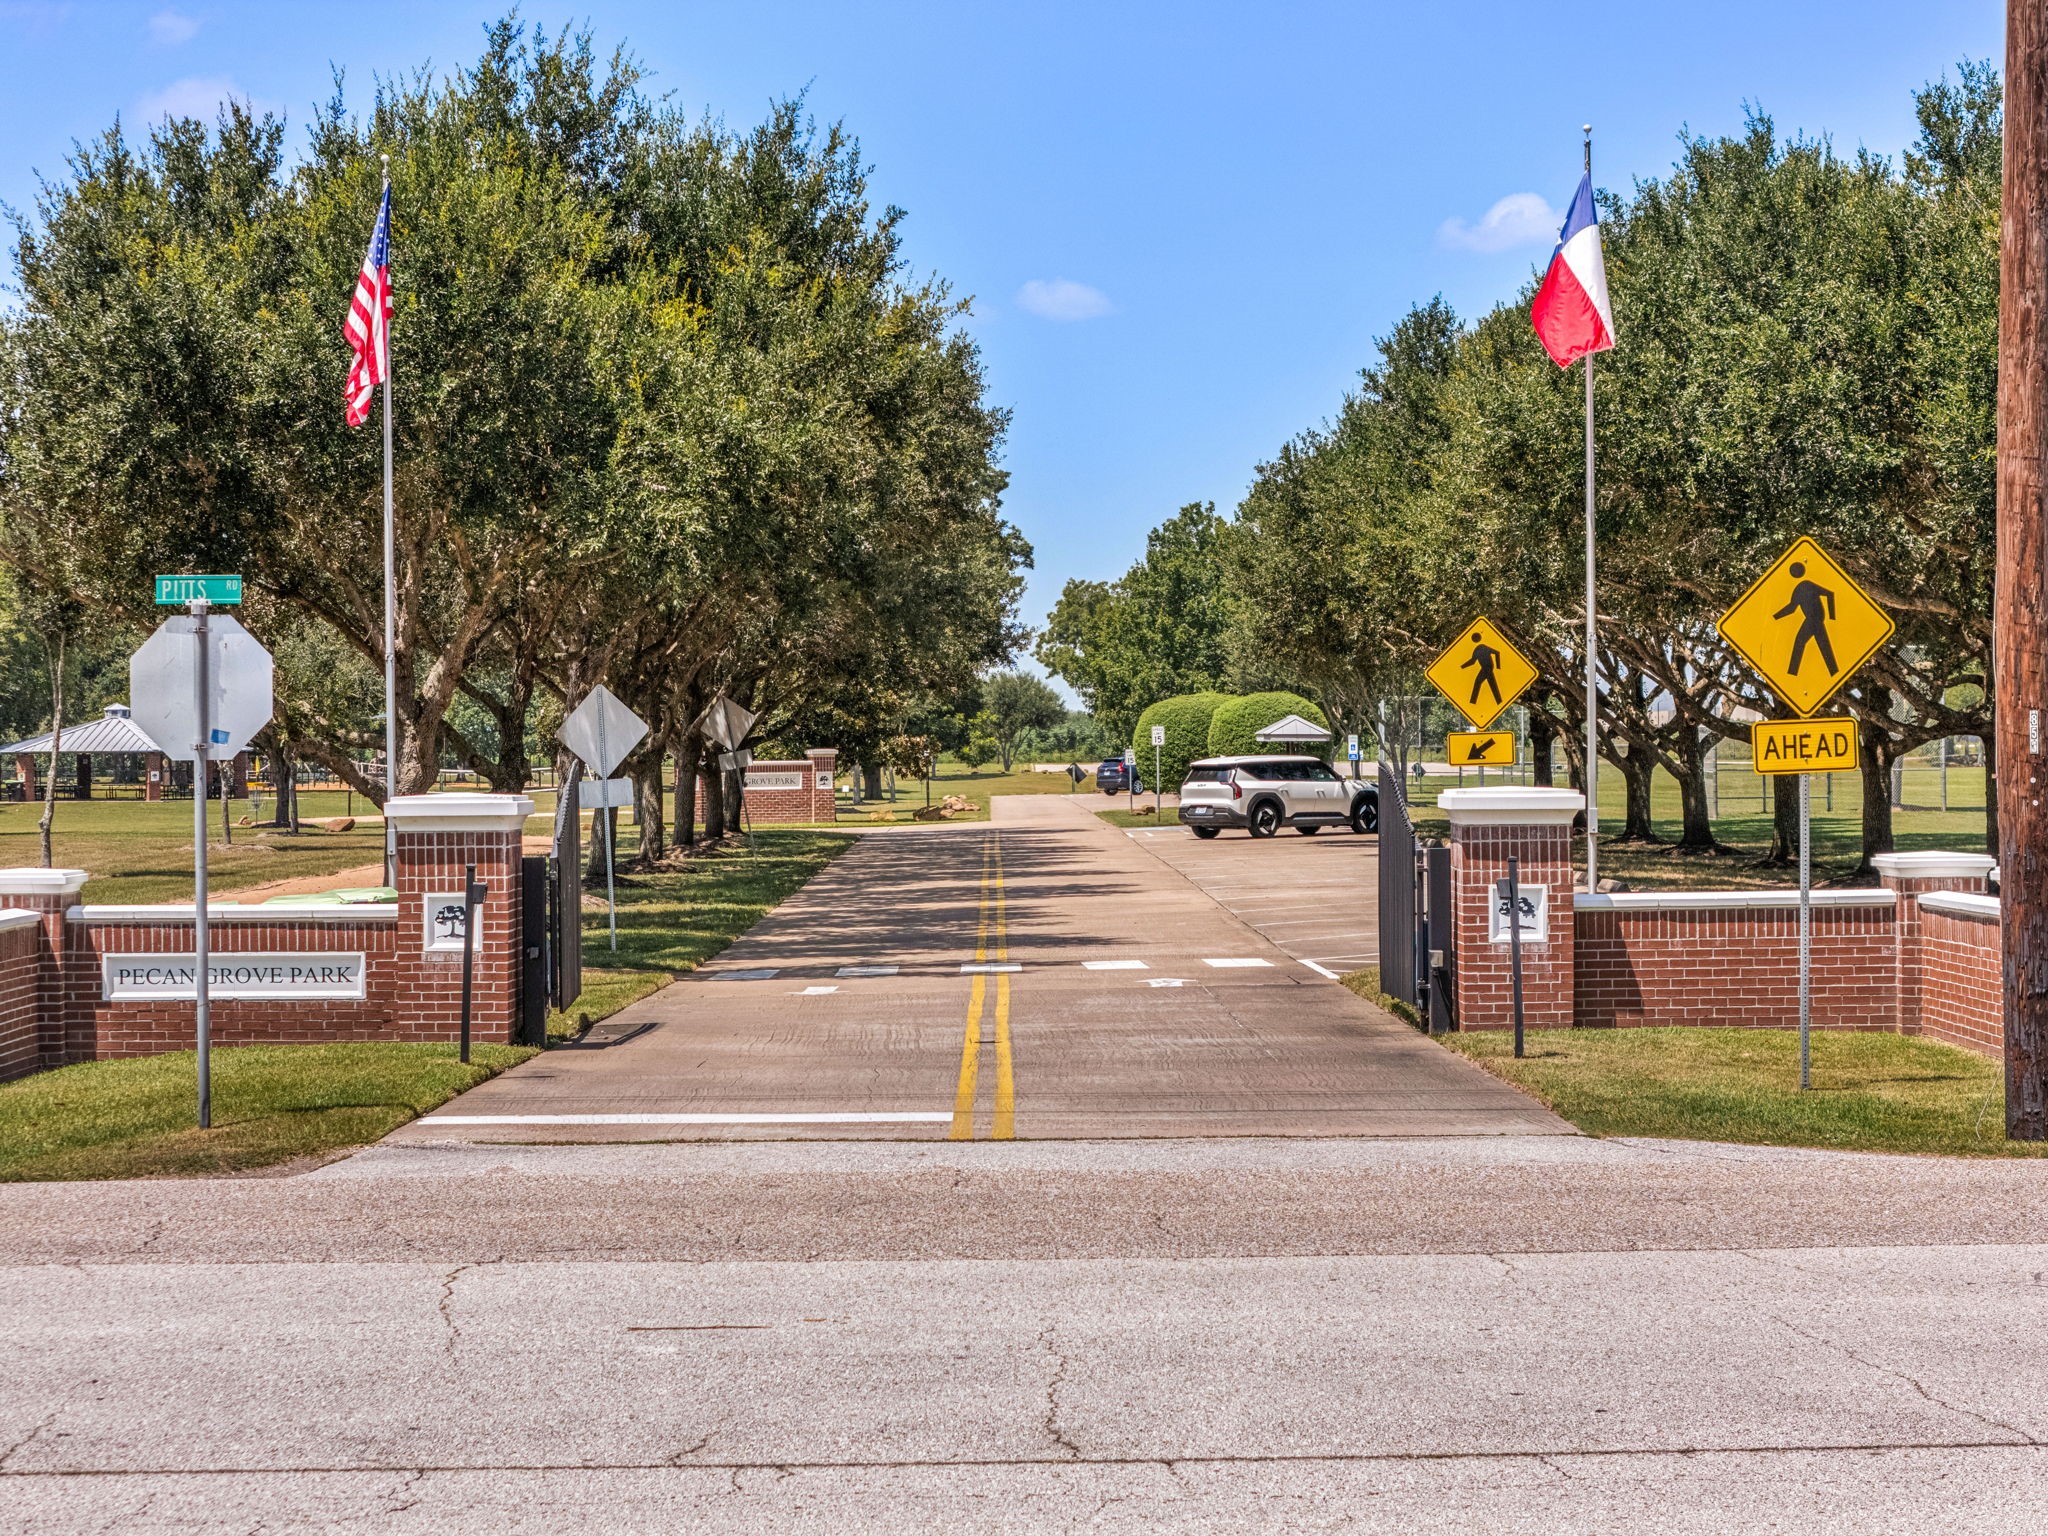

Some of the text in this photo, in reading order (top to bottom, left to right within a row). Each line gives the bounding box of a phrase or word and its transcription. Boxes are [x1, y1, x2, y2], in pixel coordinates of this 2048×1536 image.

[162, 580, 238, 600] PITTS RD
[1154, 735, 1163, 743] 15
[1764, 732, 1849, 760] AHEAD
[775, 777, 796, 785] PARK
[119, 966, 353, 985] PECAN GROVE PARK
